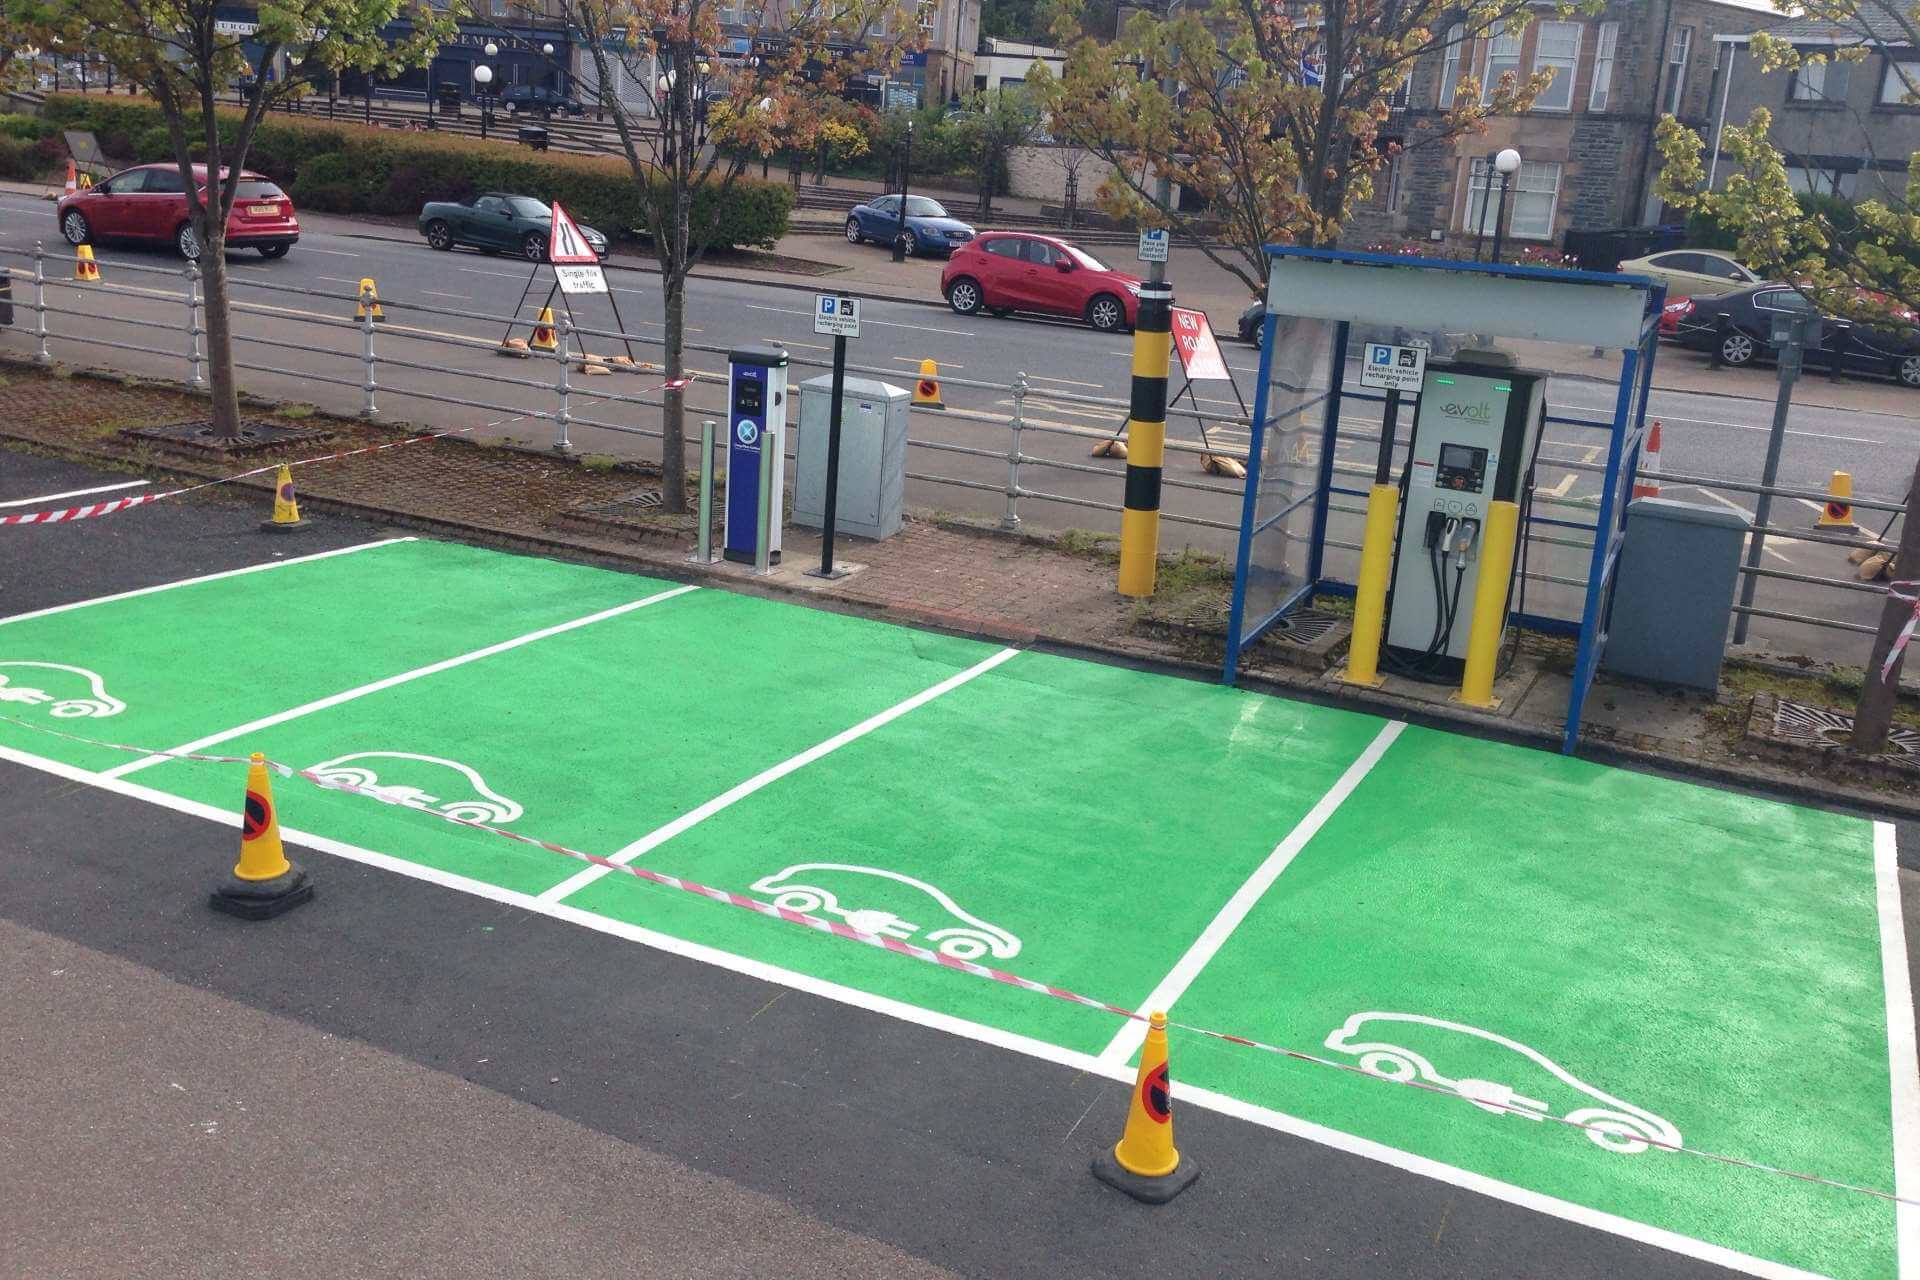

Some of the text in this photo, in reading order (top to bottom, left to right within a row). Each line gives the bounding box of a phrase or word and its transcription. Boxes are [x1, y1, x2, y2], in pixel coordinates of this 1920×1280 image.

[561, 269, 584, 279] Single
[573, 280, 595, 289] traffic
[825, 299, 833, 312] P
[1177, 313, 1198, 330] NEW
[1376, 348, 1388, 363] P
[1368, 365, 1393, 374] Electric
[1366, 372, 1400, 382] recharging
[1440, 401, 1490, 419] evolt
